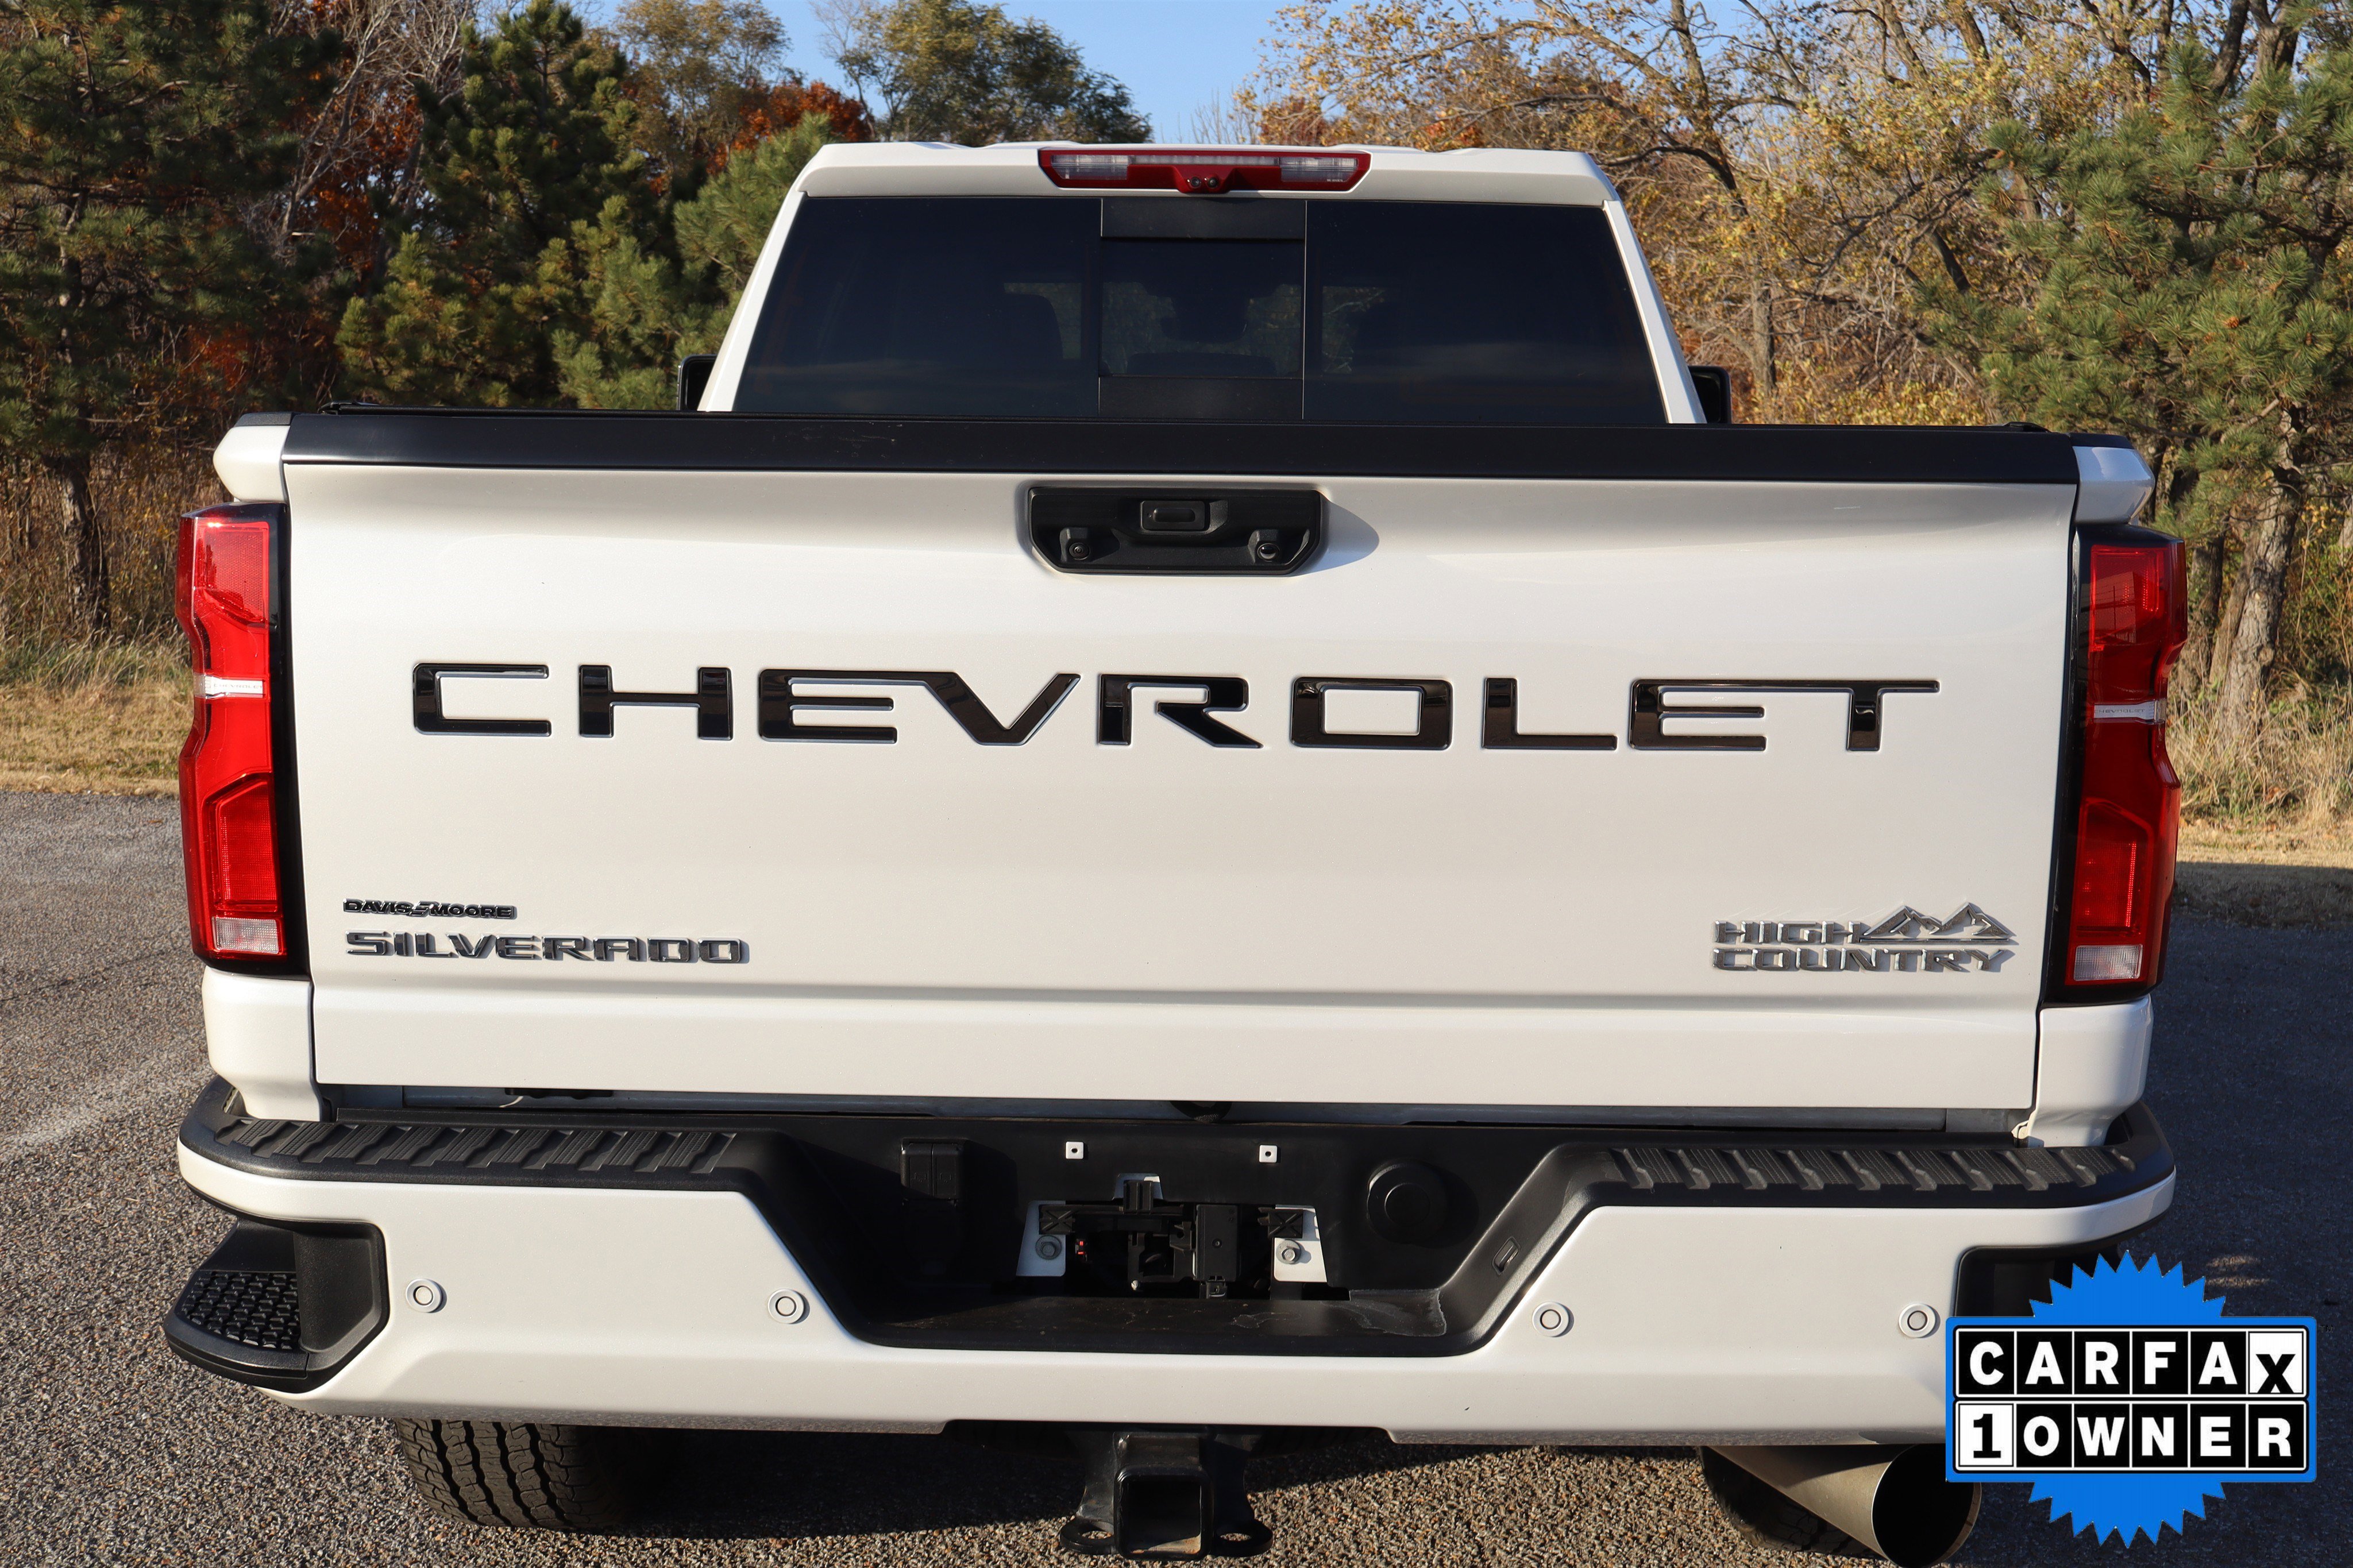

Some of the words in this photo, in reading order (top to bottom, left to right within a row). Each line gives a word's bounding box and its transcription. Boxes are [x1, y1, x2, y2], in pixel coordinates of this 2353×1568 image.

[413, 663, 1940, 751] CHEVROLET
[346, 930, 747, 963] SILVERADO
[1714, 921, 1862, 944] HIGH
[1714, 948, 2008, 971] COUNTRY
